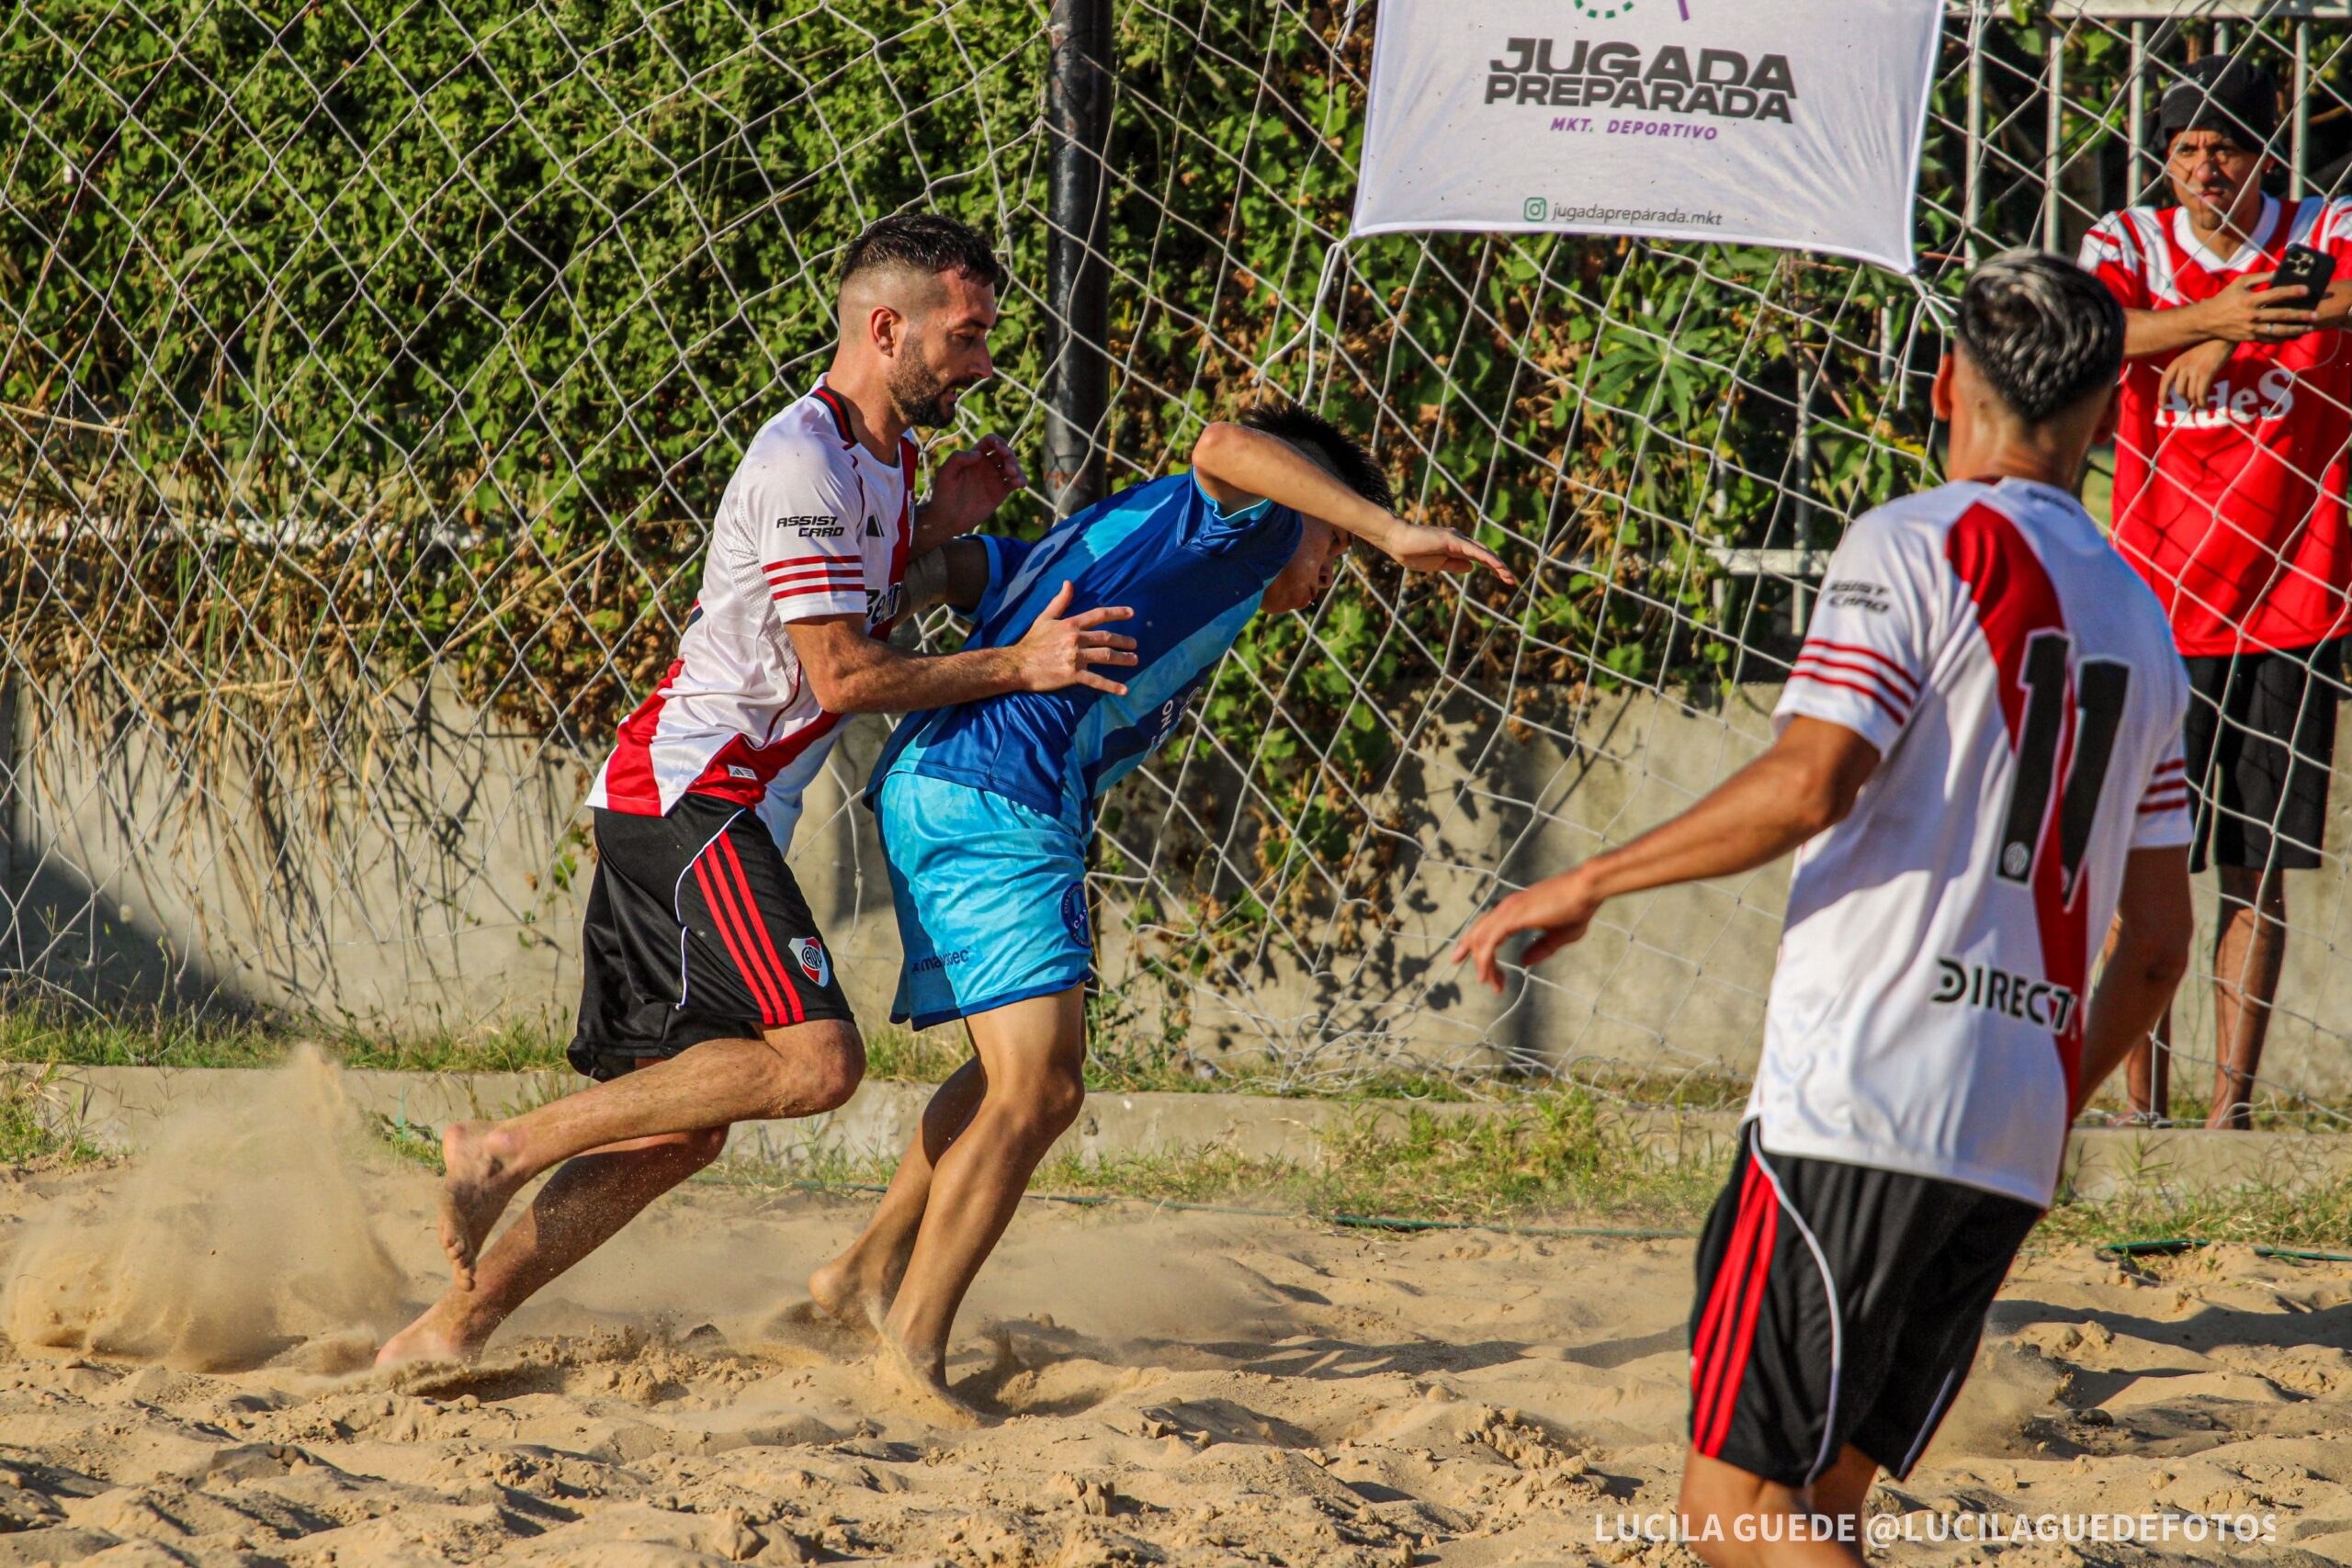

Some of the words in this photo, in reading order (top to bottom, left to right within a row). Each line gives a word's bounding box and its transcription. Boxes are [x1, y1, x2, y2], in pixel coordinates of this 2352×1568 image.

[1488, 37, 1798, 99] JUGADA
[1483, 73, 1794, 124] PREPARADA
[1550, 118, 1595, 133] MKT.
[1606, 119, 1718, 141] DEPORTIVO
[1552, 202, 1724, 226] jugadapreparada.mkt
[775, 515, 838, 529] ASSIST
[797, 526, 845, 537] CARD
[1996, 626, 2131, 911] 11
[1930, 954, 2079, 1040] DIRECT
